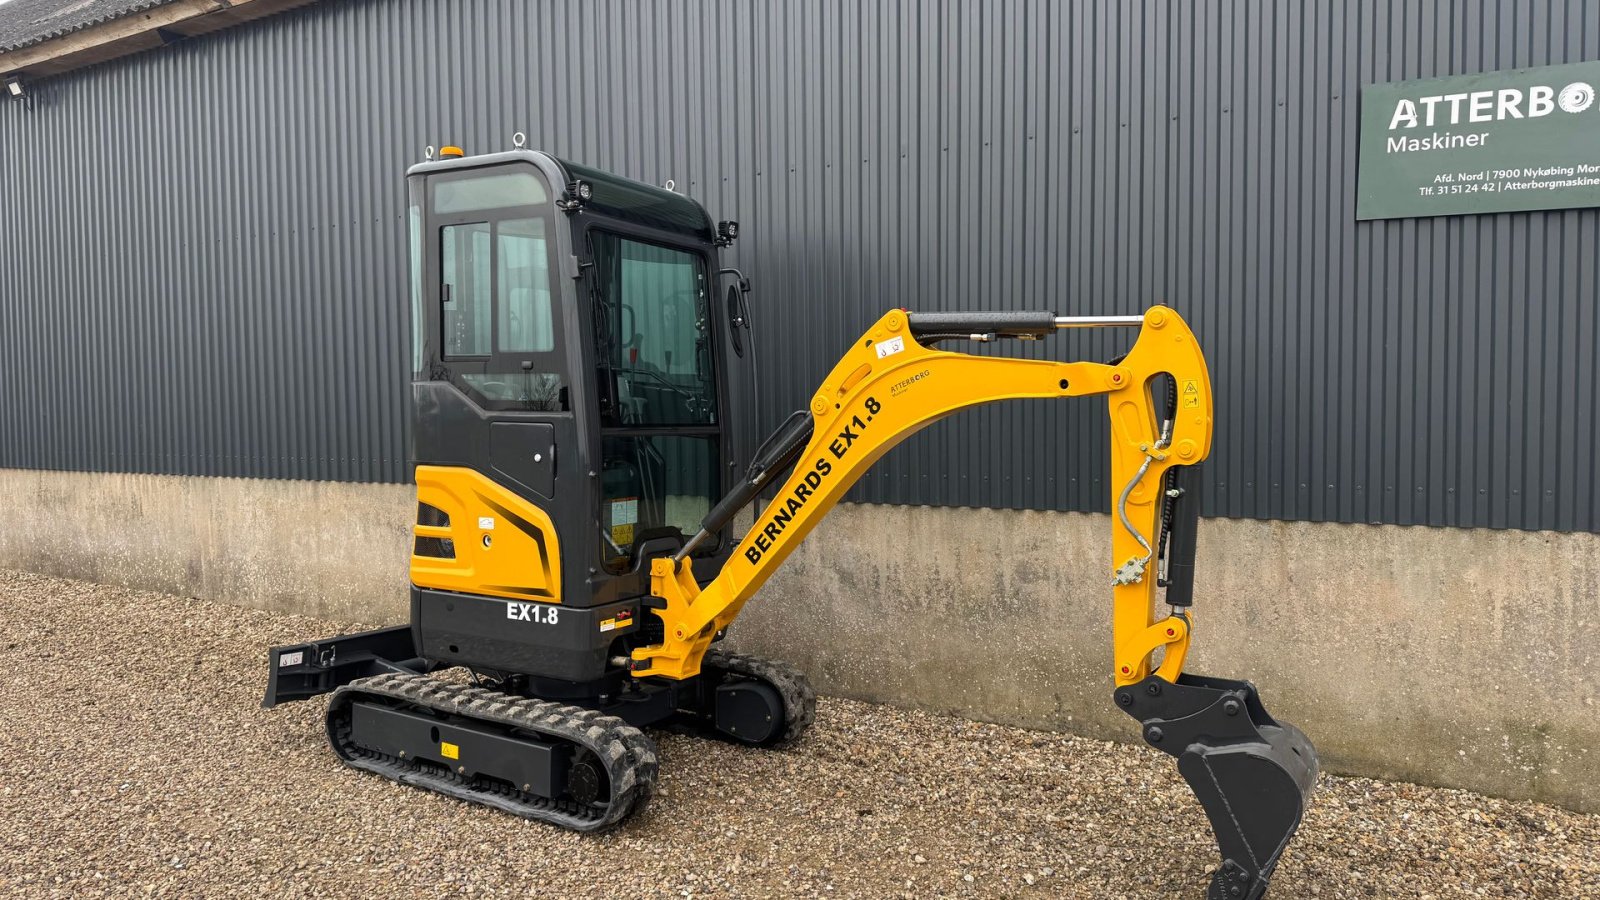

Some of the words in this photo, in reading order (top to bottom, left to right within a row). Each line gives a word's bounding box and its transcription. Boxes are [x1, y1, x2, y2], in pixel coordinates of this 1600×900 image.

[1388, 82, 1600, 129] ATTERBO
[1387, 132, 1489, 153] Maskiner
[1434, 173, 1454, 183] Afd.
[1458, 172, 1483, 182] Nord
[1493, 169, 1520, 179] 7900
[1524, 166, 1574, 178] Nykøbing
[1419, 186, 1434, 196] Tlf.
[1438, 186, 1448, 194] 31
[1451, 185, 1461, 194] 51
[1465, 184, 1478, 193] 24
[1481, 182, 1495, 192] 42
[744, 458, 832, 565] BERNARDS
[829, 396, 882, 459] EX1.8
[507, 602, 558, 625] EX1.8
